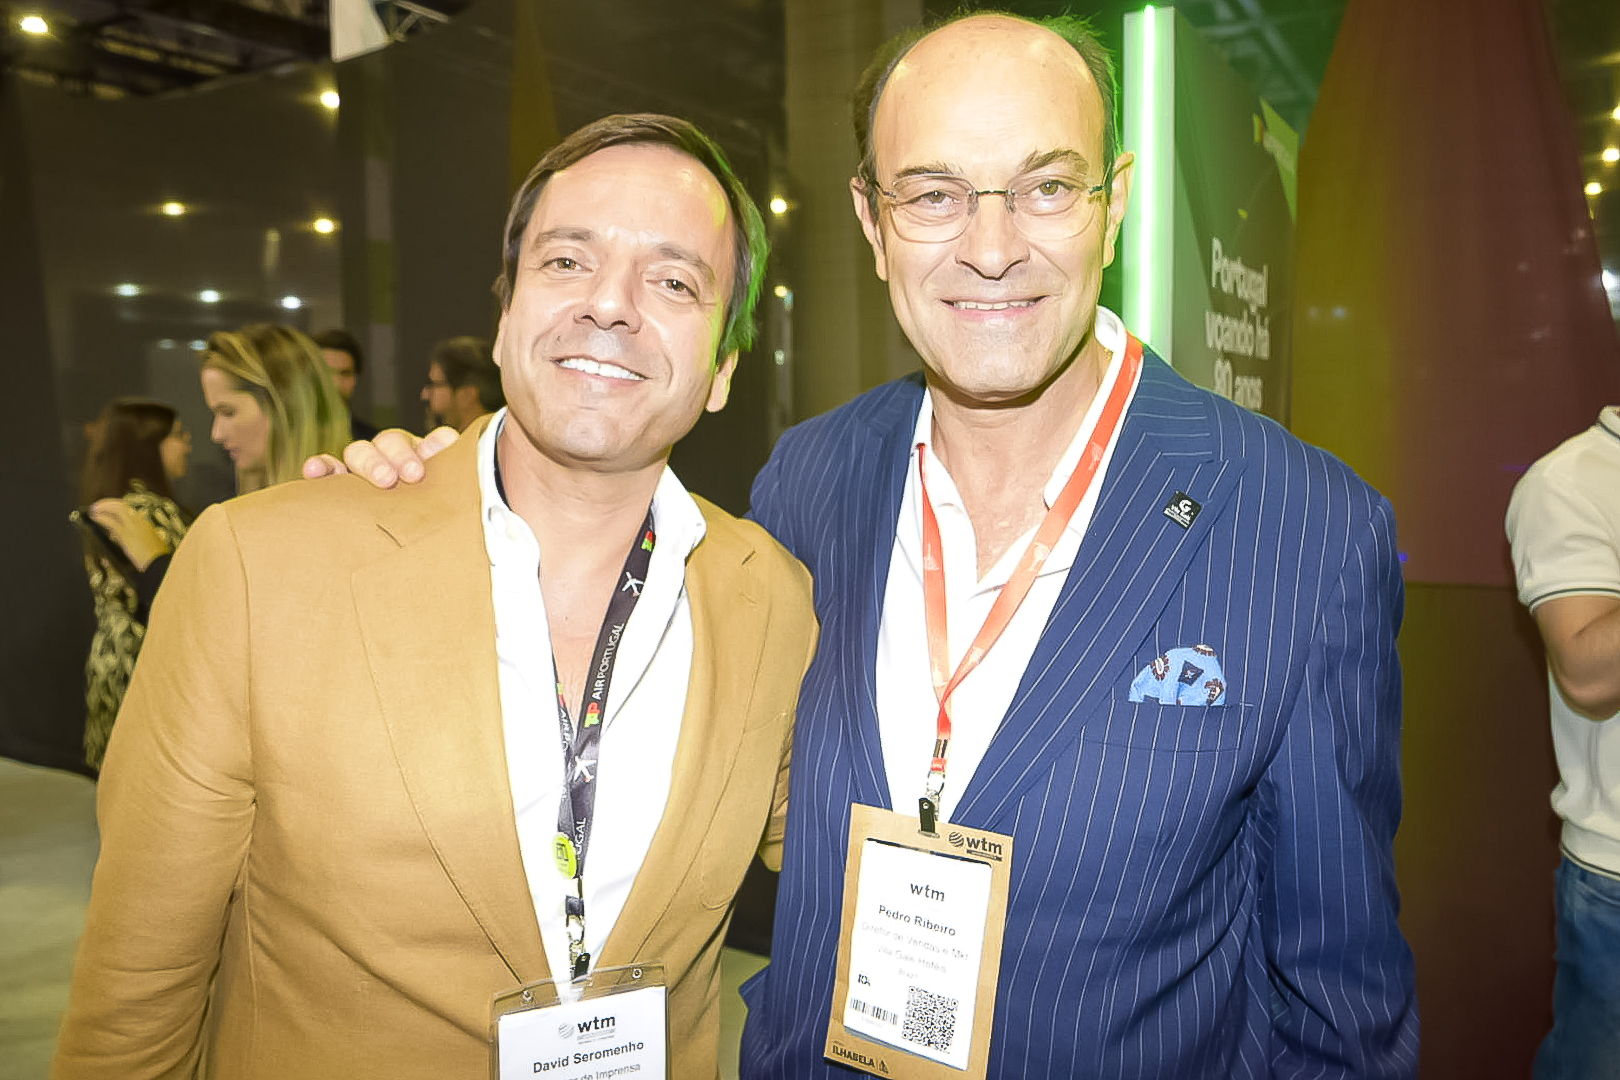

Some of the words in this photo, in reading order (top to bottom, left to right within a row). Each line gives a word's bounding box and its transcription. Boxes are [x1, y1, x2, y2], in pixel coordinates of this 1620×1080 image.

[966, 836, 1002, 856] wtm
[910, 883, 945, 902] wtm
[879, 904, 911, 923] Pedro
[914, 915, 956, 937] Ribeiro
[577, 1016, 616, 1033] wtm
[533, 1055, 569, 1073] David
[573, 1041, 644, 1065] Seromenho
[832, 1044, 875, 1068] ILHABELA
[595, 1063, 641, 1080] Imprensa
